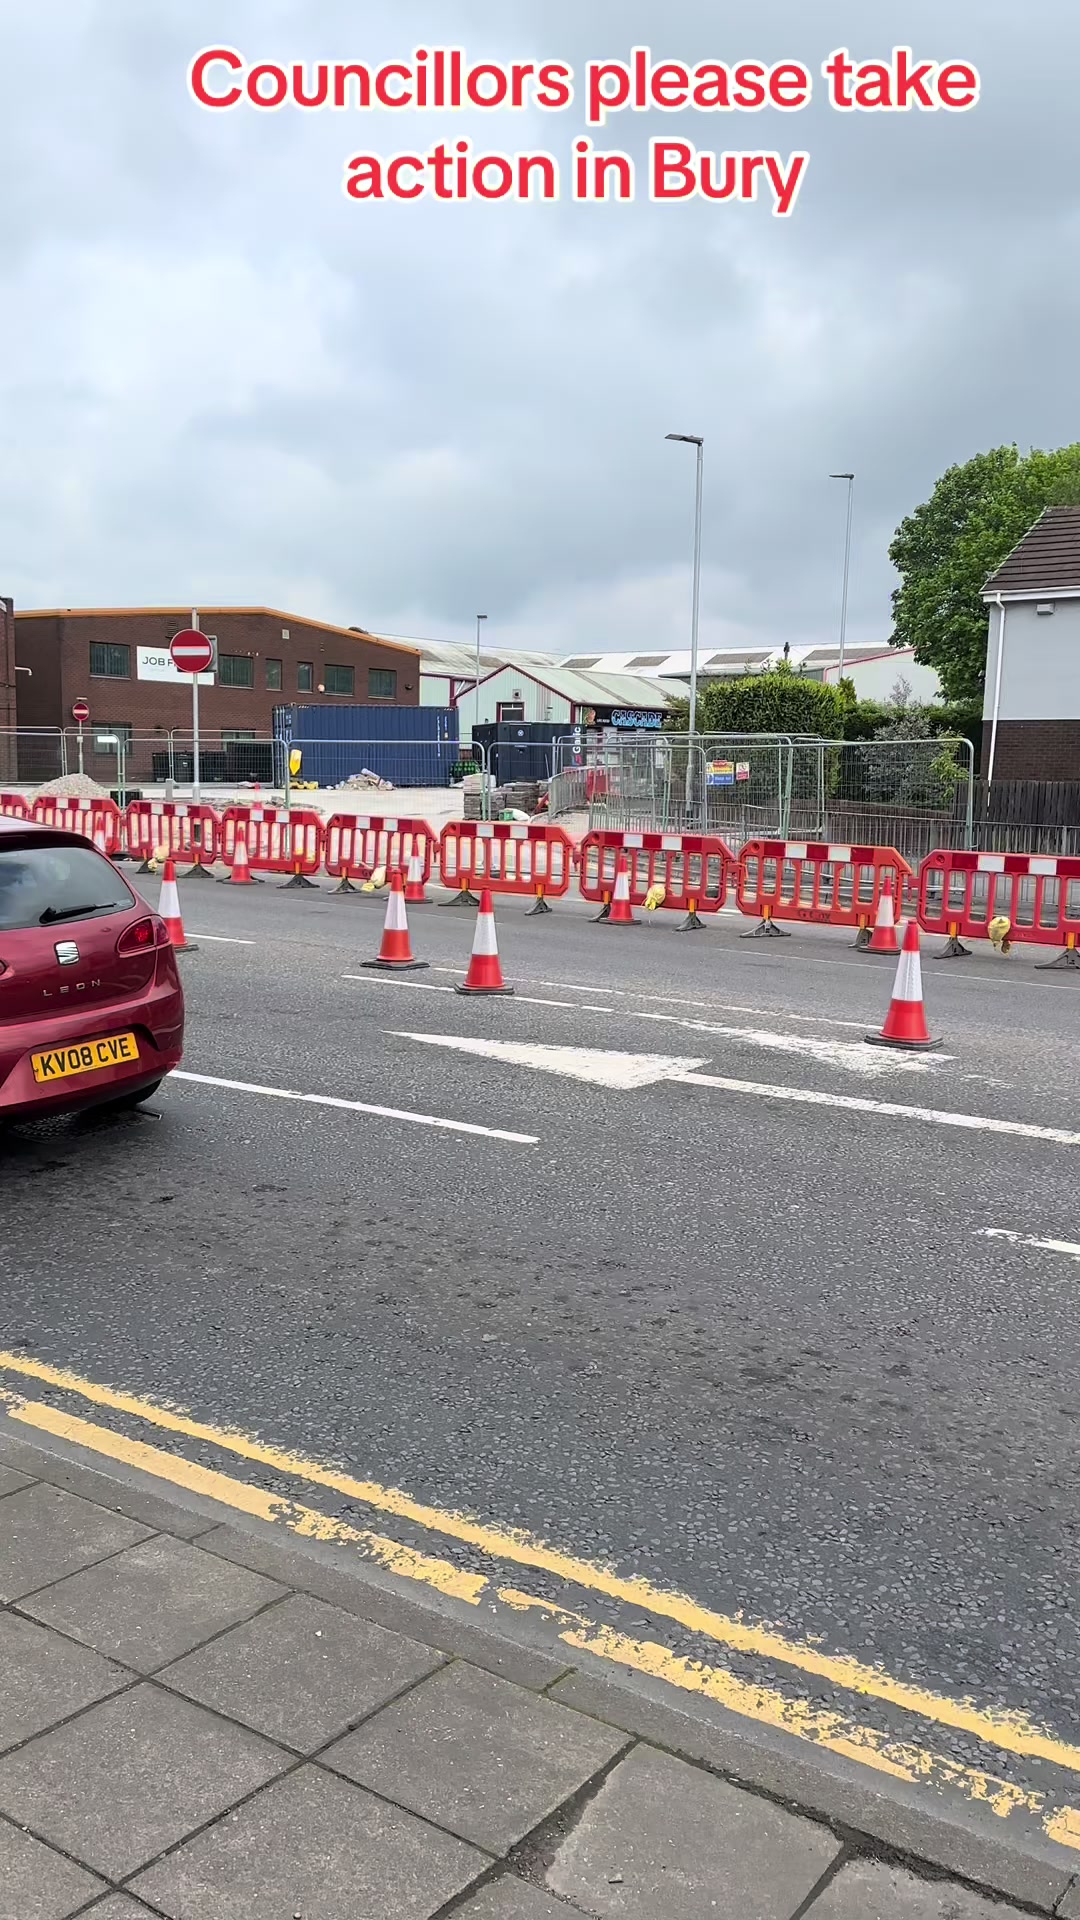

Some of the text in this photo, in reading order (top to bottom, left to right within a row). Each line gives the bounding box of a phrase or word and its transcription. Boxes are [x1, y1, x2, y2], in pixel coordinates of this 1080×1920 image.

[142, 656, 165, 666] JOB
[611, 709, 662, 728] CASCADE
[43, 979, 100, 996] LEON
[40, 1037, 131, 1076] KV08 CVE
